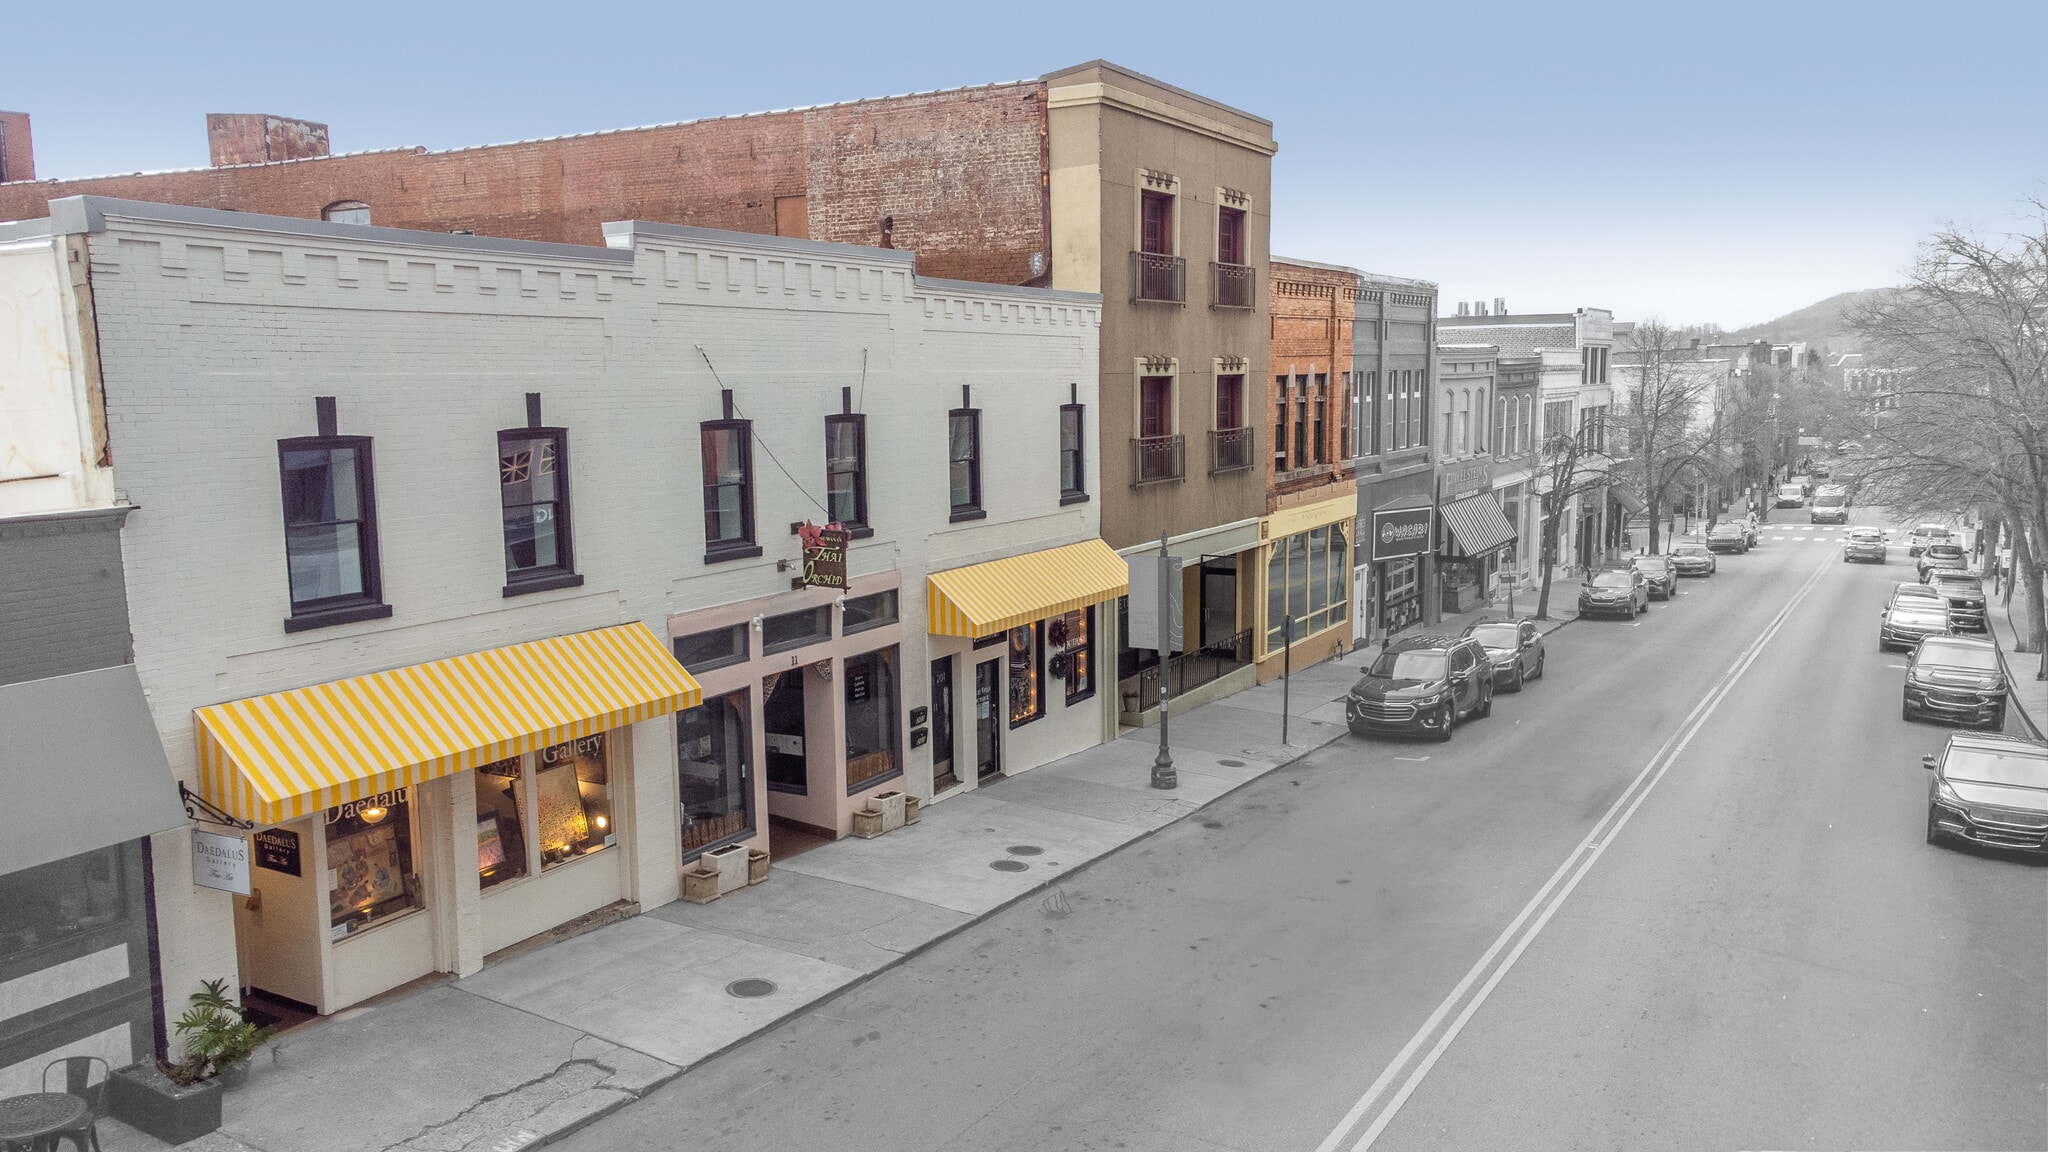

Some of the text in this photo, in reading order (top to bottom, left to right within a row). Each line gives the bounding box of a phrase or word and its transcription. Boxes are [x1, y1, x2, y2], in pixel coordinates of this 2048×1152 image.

[1395, 522, 1428, 538] WASABI
[804, 546, 842, 563] THAI
[802, 560, 843, 585] ORCHID
[543, 735, 602, 763] Gallery
[324, 788, 408, 825] Daedalu
[197, 841, 244, 861] DAEDALUS
[256, 832, 296, 850] DAEDALUS
